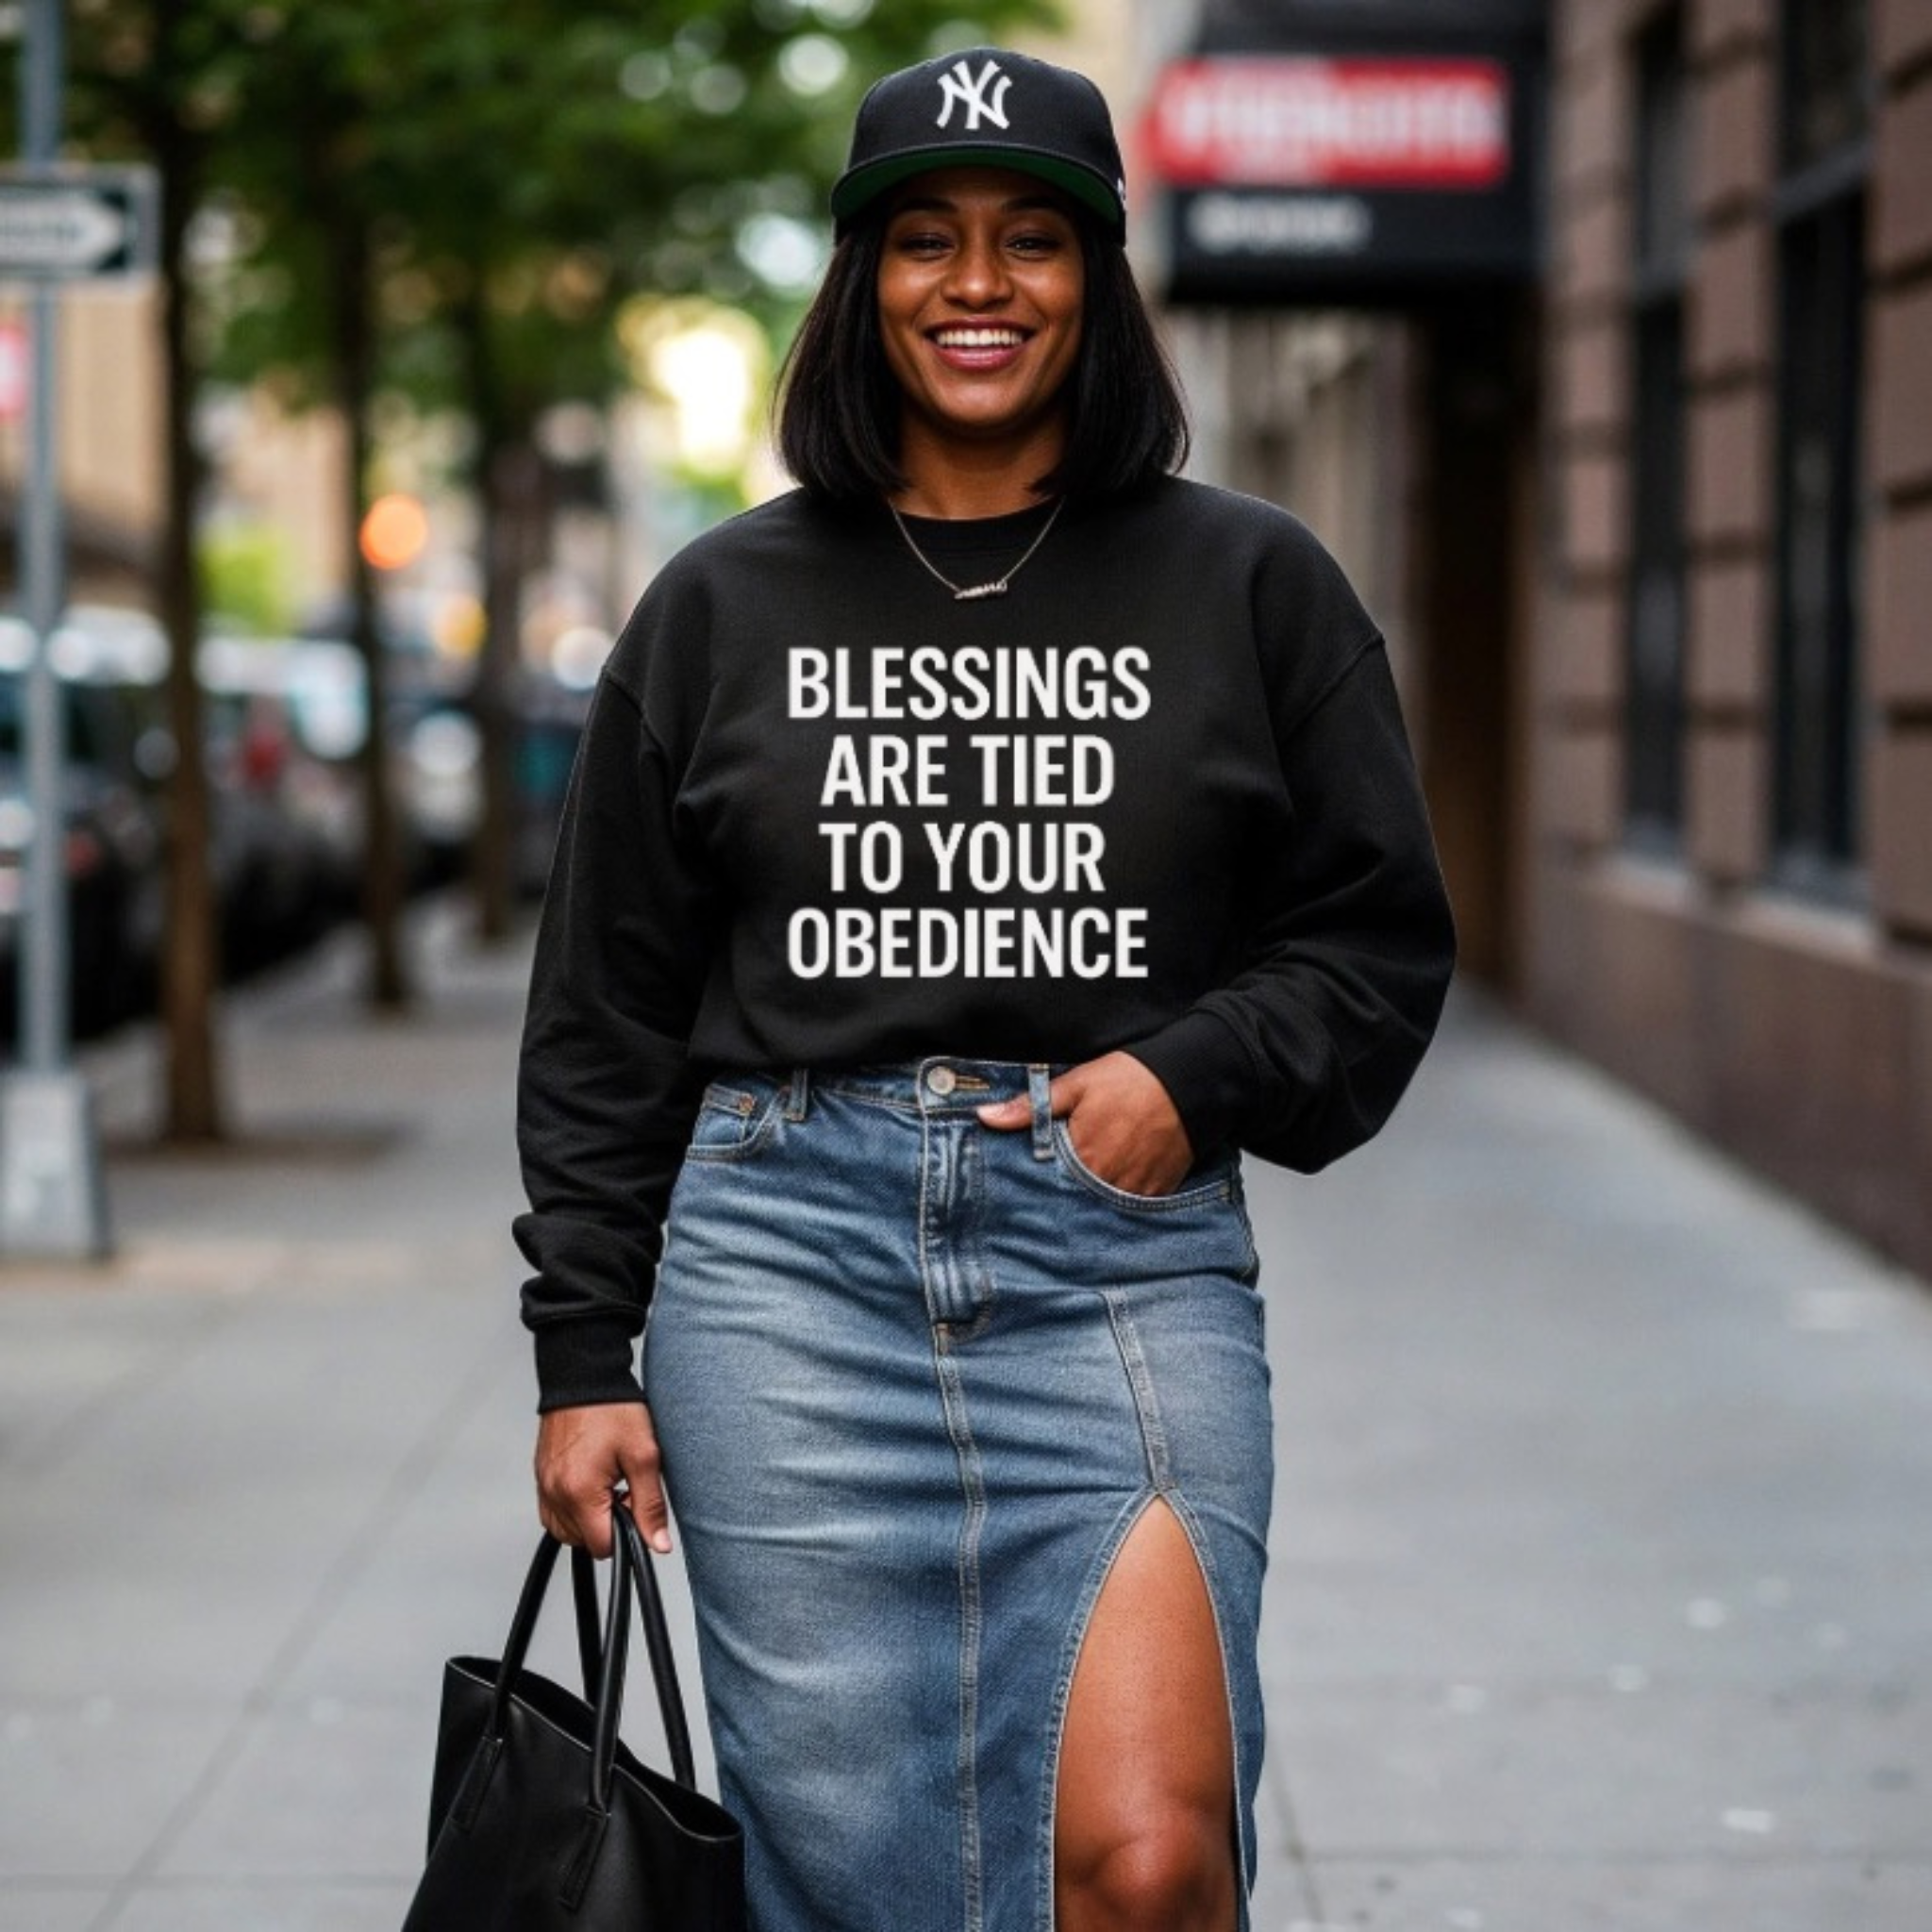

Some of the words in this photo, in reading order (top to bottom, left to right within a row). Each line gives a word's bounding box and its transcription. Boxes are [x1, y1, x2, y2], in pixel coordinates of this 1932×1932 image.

[936, 59, 1013, 130] NY
[788, 647, 1151, 720] BLESSINGS
[821, 735, 948, 806] ARE
[970, 735, 1114, 806] TIED
[819, 821, 902, 893] TO
[924, 821, 1106, 893] YOUR
[788, 908, 1148, 979] OBEDIENCE
